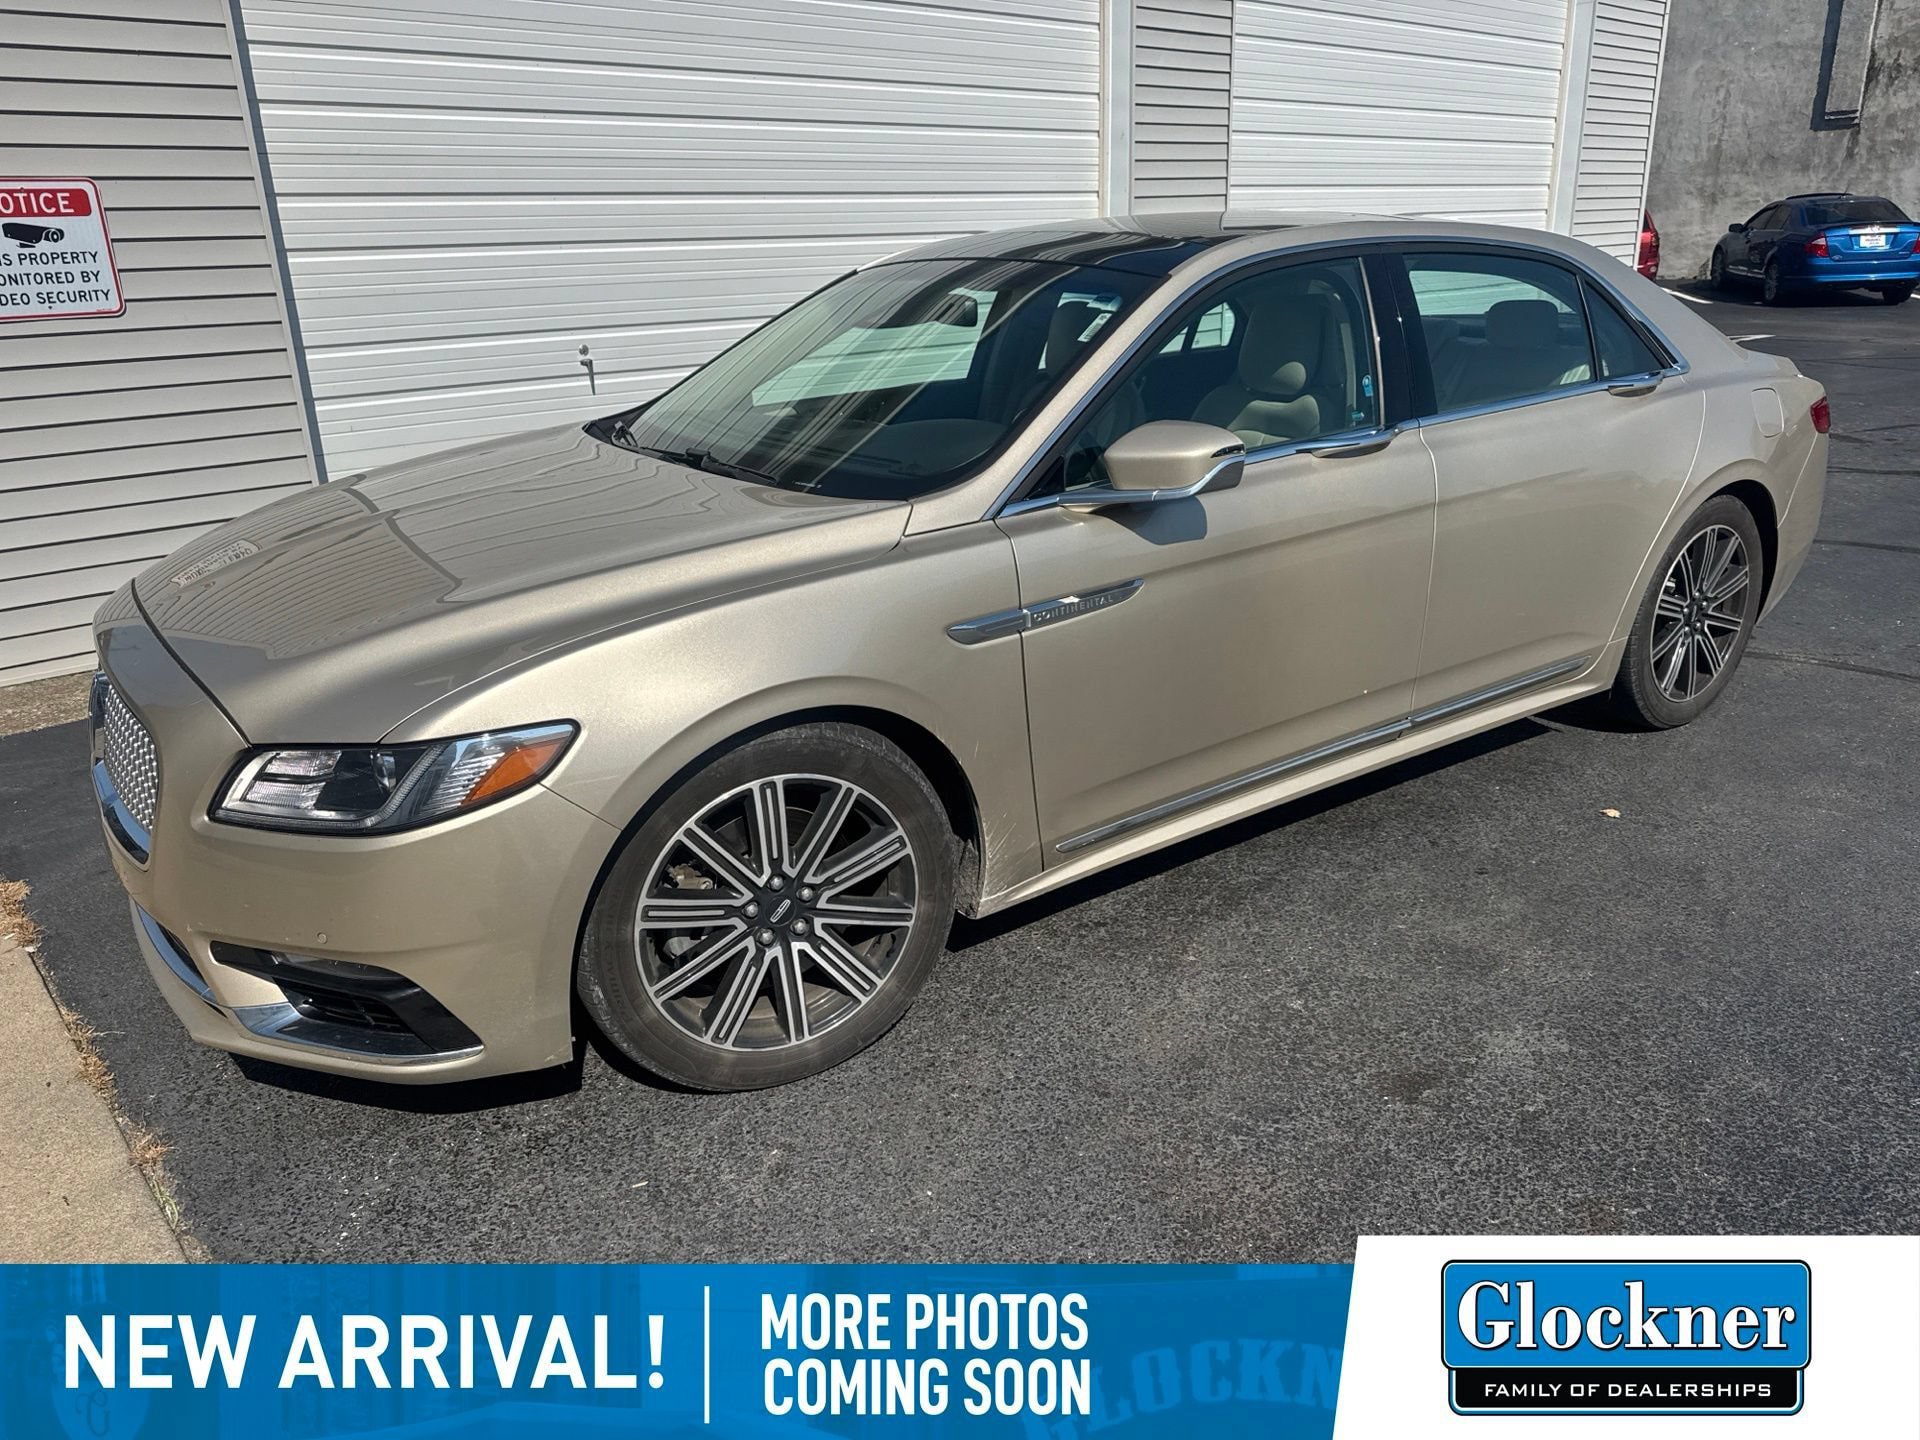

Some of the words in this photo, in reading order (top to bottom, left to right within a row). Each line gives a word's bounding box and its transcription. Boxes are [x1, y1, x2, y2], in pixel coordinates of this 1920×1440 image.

[0, 192, 75, 214] OTICE
[18, 250, 98, 266] PROPERTY
[0, 271, 75, 287] ONITORED
[81, 270, 100, 283] BY
[0, 293, 31, 306] DEO
[36, 289, 111, 304] SECURITY
[1033, 594, 1113, 621] CONTINENTAL
